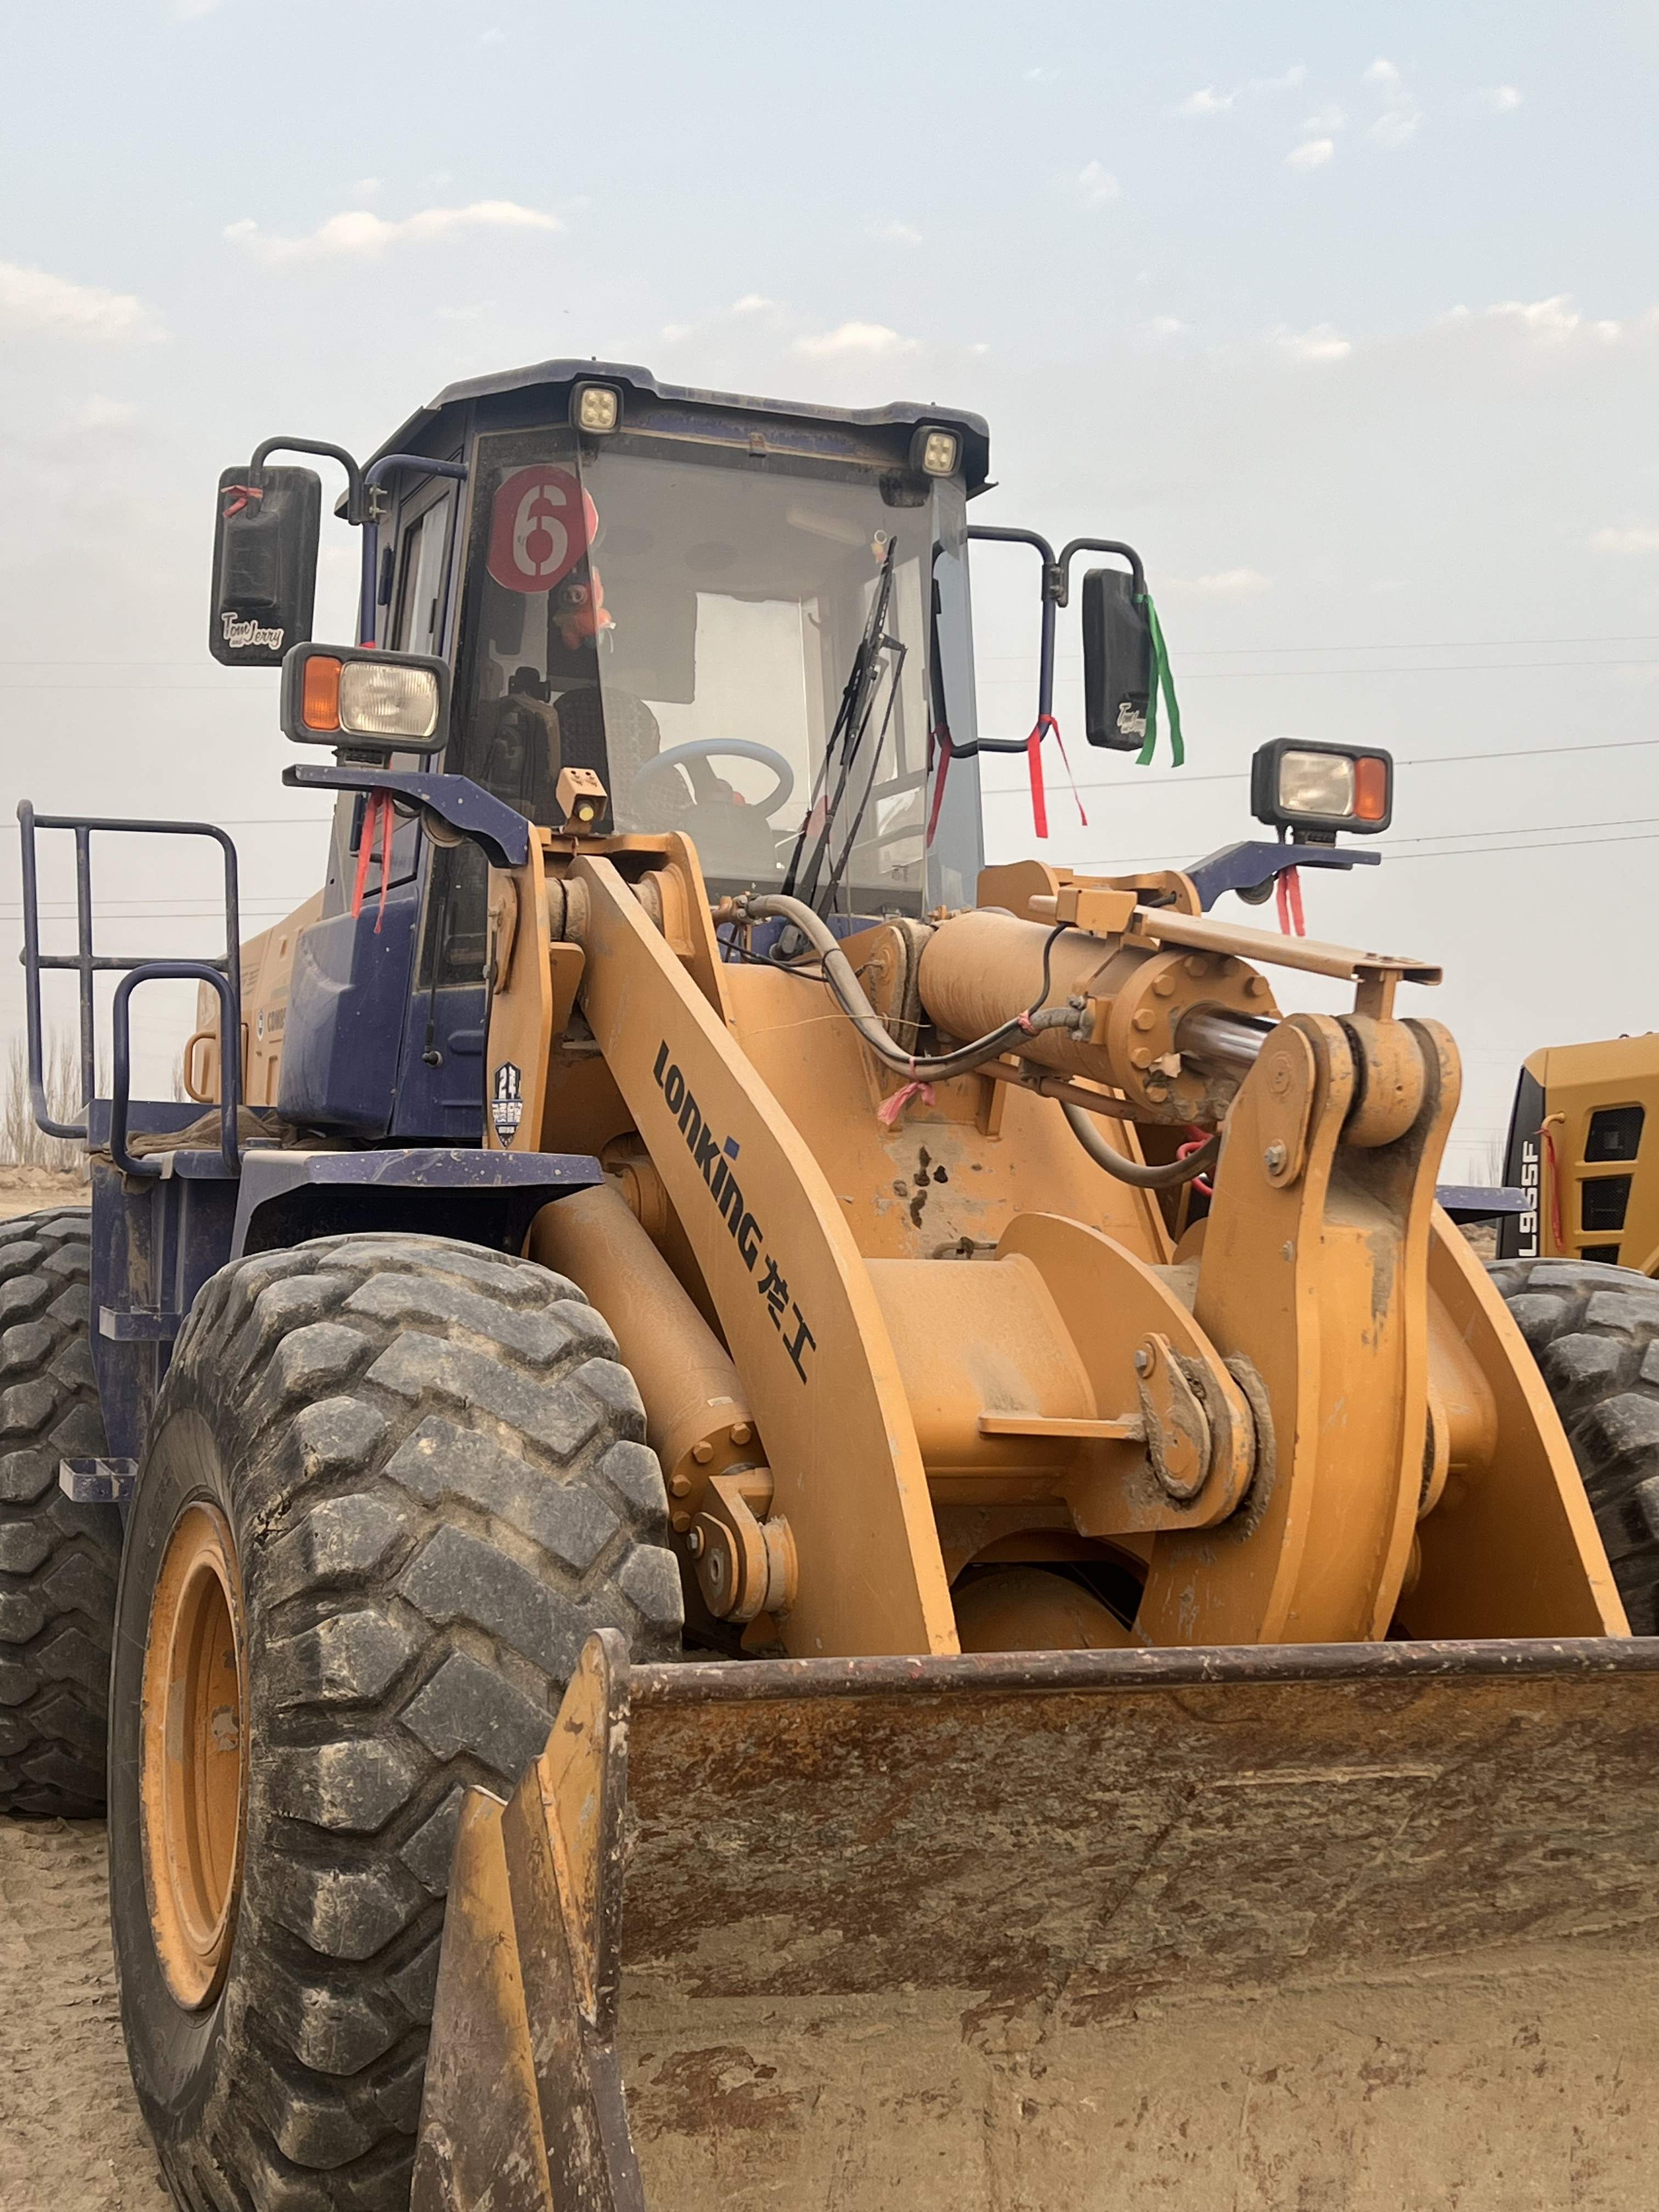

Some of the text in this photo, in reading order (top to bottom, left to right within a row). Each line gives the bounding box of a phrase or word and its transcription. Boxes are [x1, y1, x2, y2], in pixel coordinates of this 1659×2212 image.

[512, 484, 569, 576] 6
[222, 613, 250, 638] Tom
[244, 622, 282, 647] Jerry
